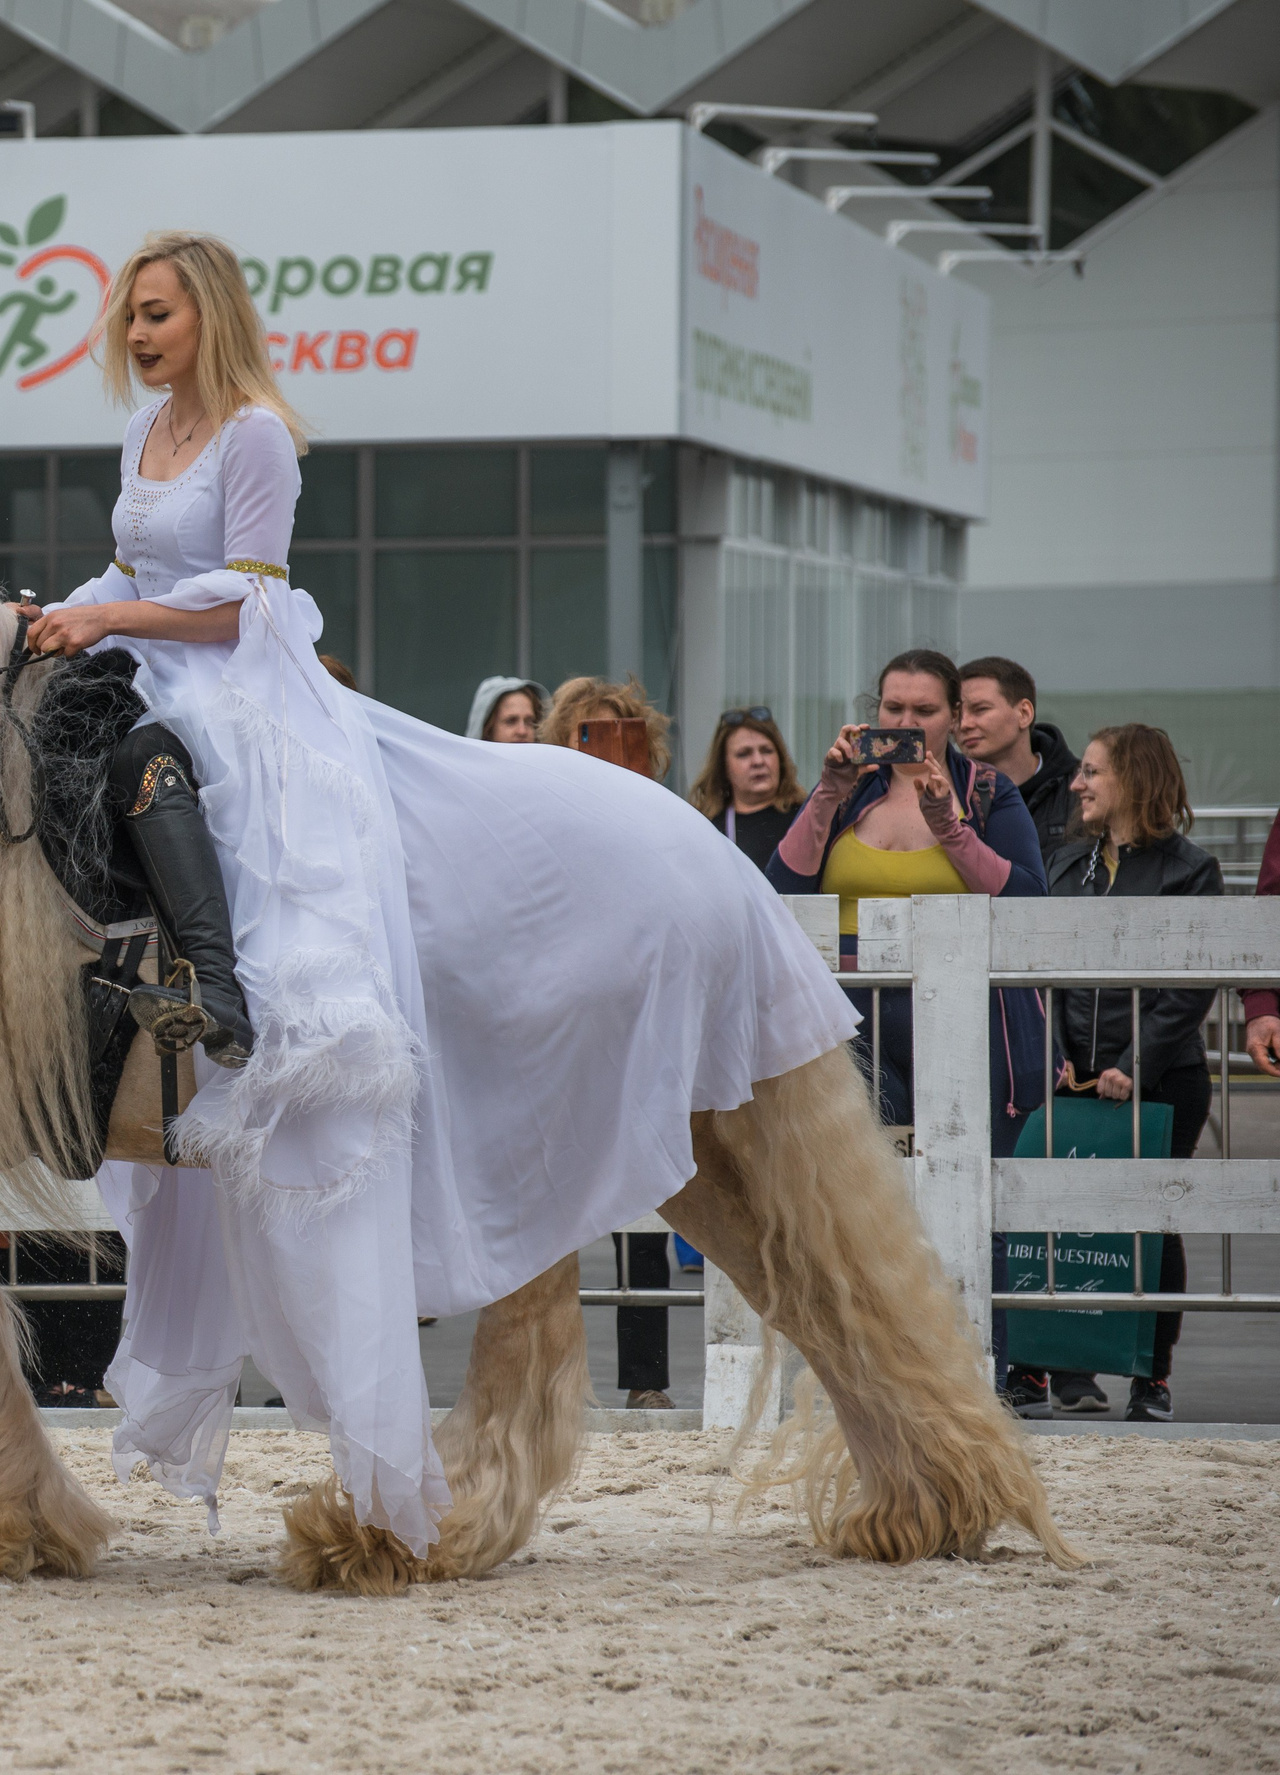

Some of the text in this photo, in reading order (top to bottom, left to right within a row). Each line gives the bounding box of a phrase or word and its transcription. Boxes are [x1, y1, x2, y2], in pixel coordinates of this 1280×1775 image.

[240, 251, 495, 315] оровая
[264, 327, 418, 374] сква
[1006, 1243, 1034, 1260] LIBI
